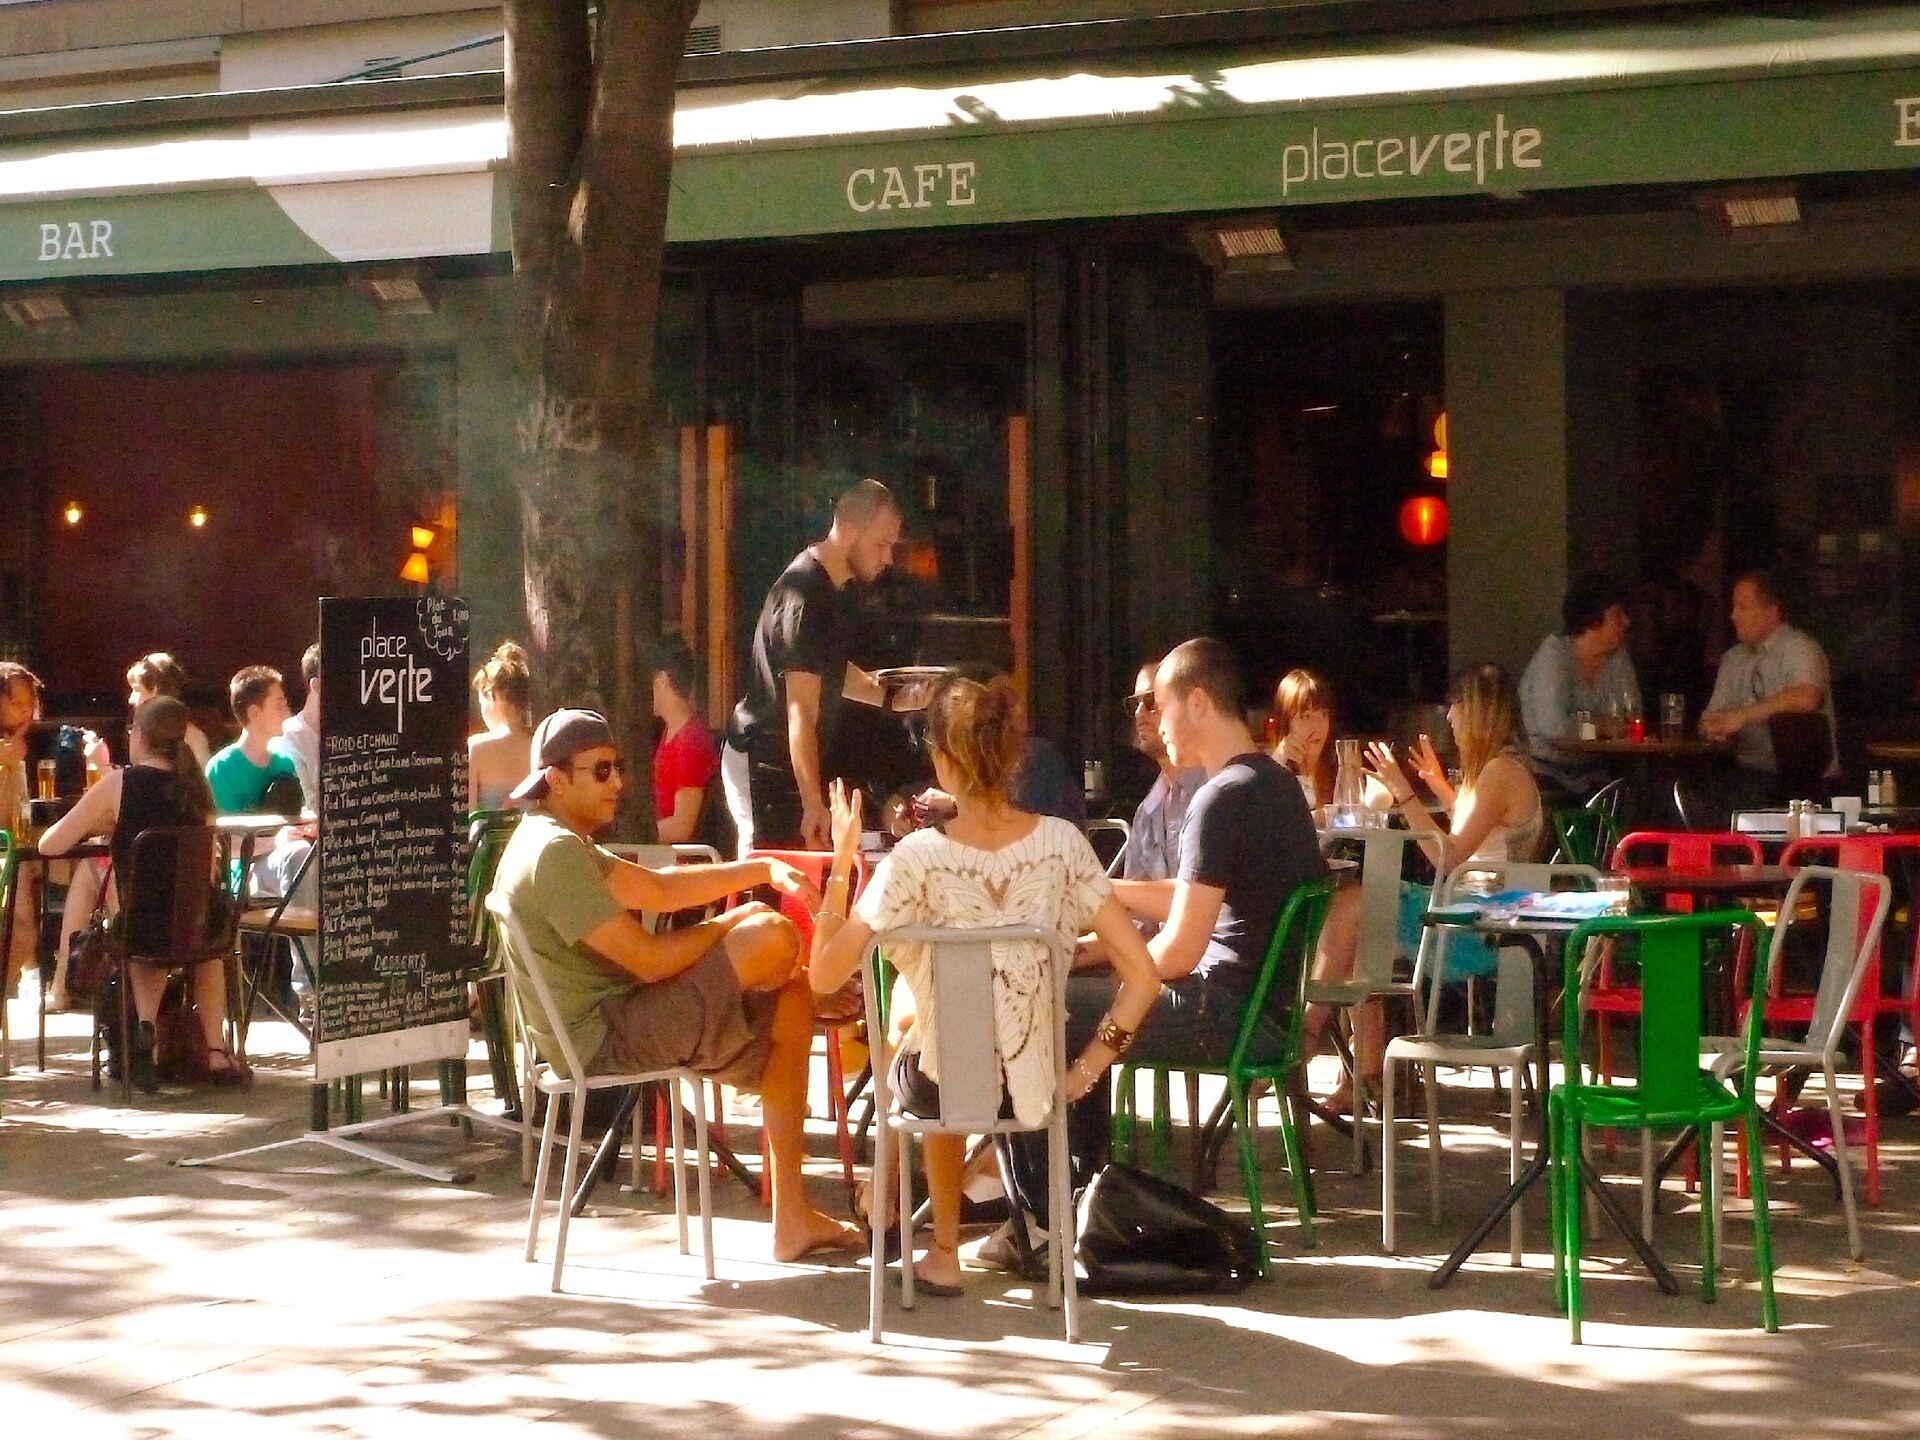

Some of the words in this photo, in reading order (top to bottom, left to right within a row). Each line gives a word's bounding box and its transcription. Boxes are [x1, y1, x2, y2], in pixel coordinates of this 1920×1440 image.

[847, 162, 975, 212] CAFE
[38, 220, 113, 261] BAR
[427, 598, 446, 614] Plat
[432, 613, 442, 624] du
[361, 615, 407, 665] place
[361, 653, 433, 734] verte
[356, 734, 370, 750] ET
[370, 733, 399, 748] CHAUD
[374, 951, 427, 972] DESSERTS
